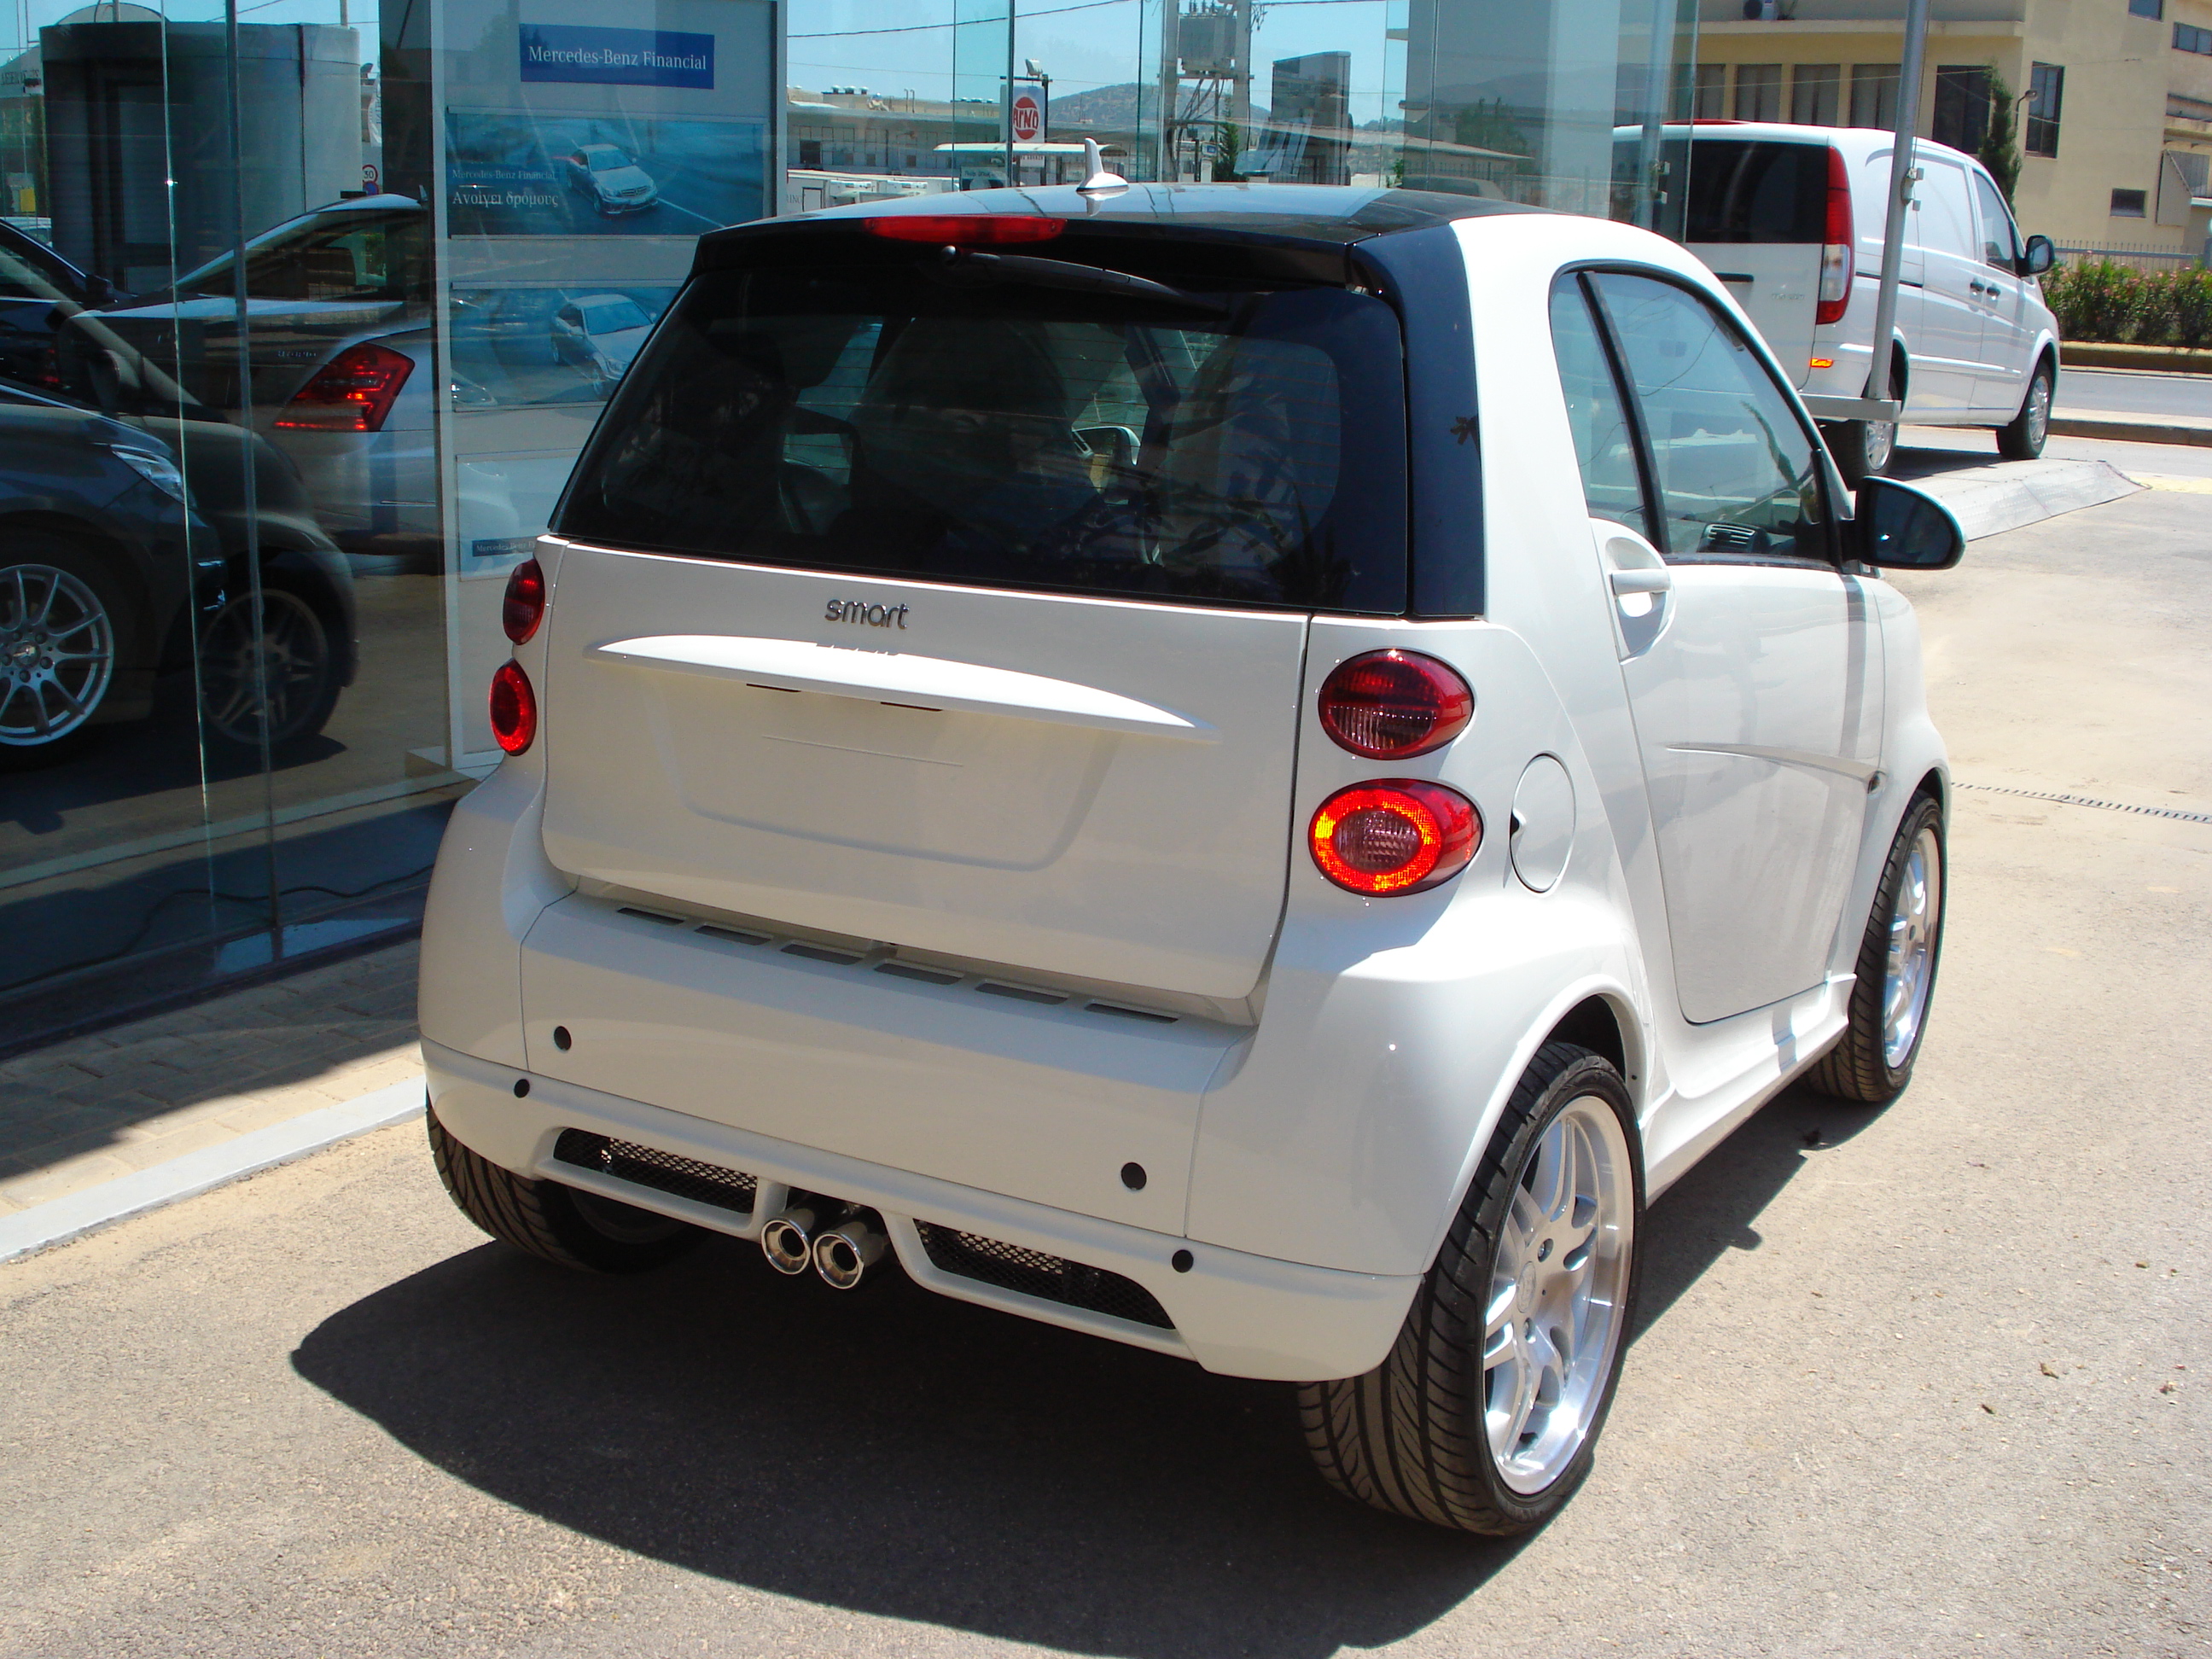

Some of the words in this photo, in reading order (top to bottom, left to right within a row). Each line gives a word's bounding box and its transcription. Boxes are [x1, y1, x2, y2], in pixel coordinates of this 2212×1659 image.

[528, 45, 638, 66] Mercedes-Benz
[643, 51, 707, 70] Financial
[452, 169, 515, 179] Mercedes-Benz
[518, 171, 556, 180] Financial
[452, 190, 502, 207] Ανοίγει
[506, 190, 559, 208] δρόμους
[824, 599, 910, 630] smart
